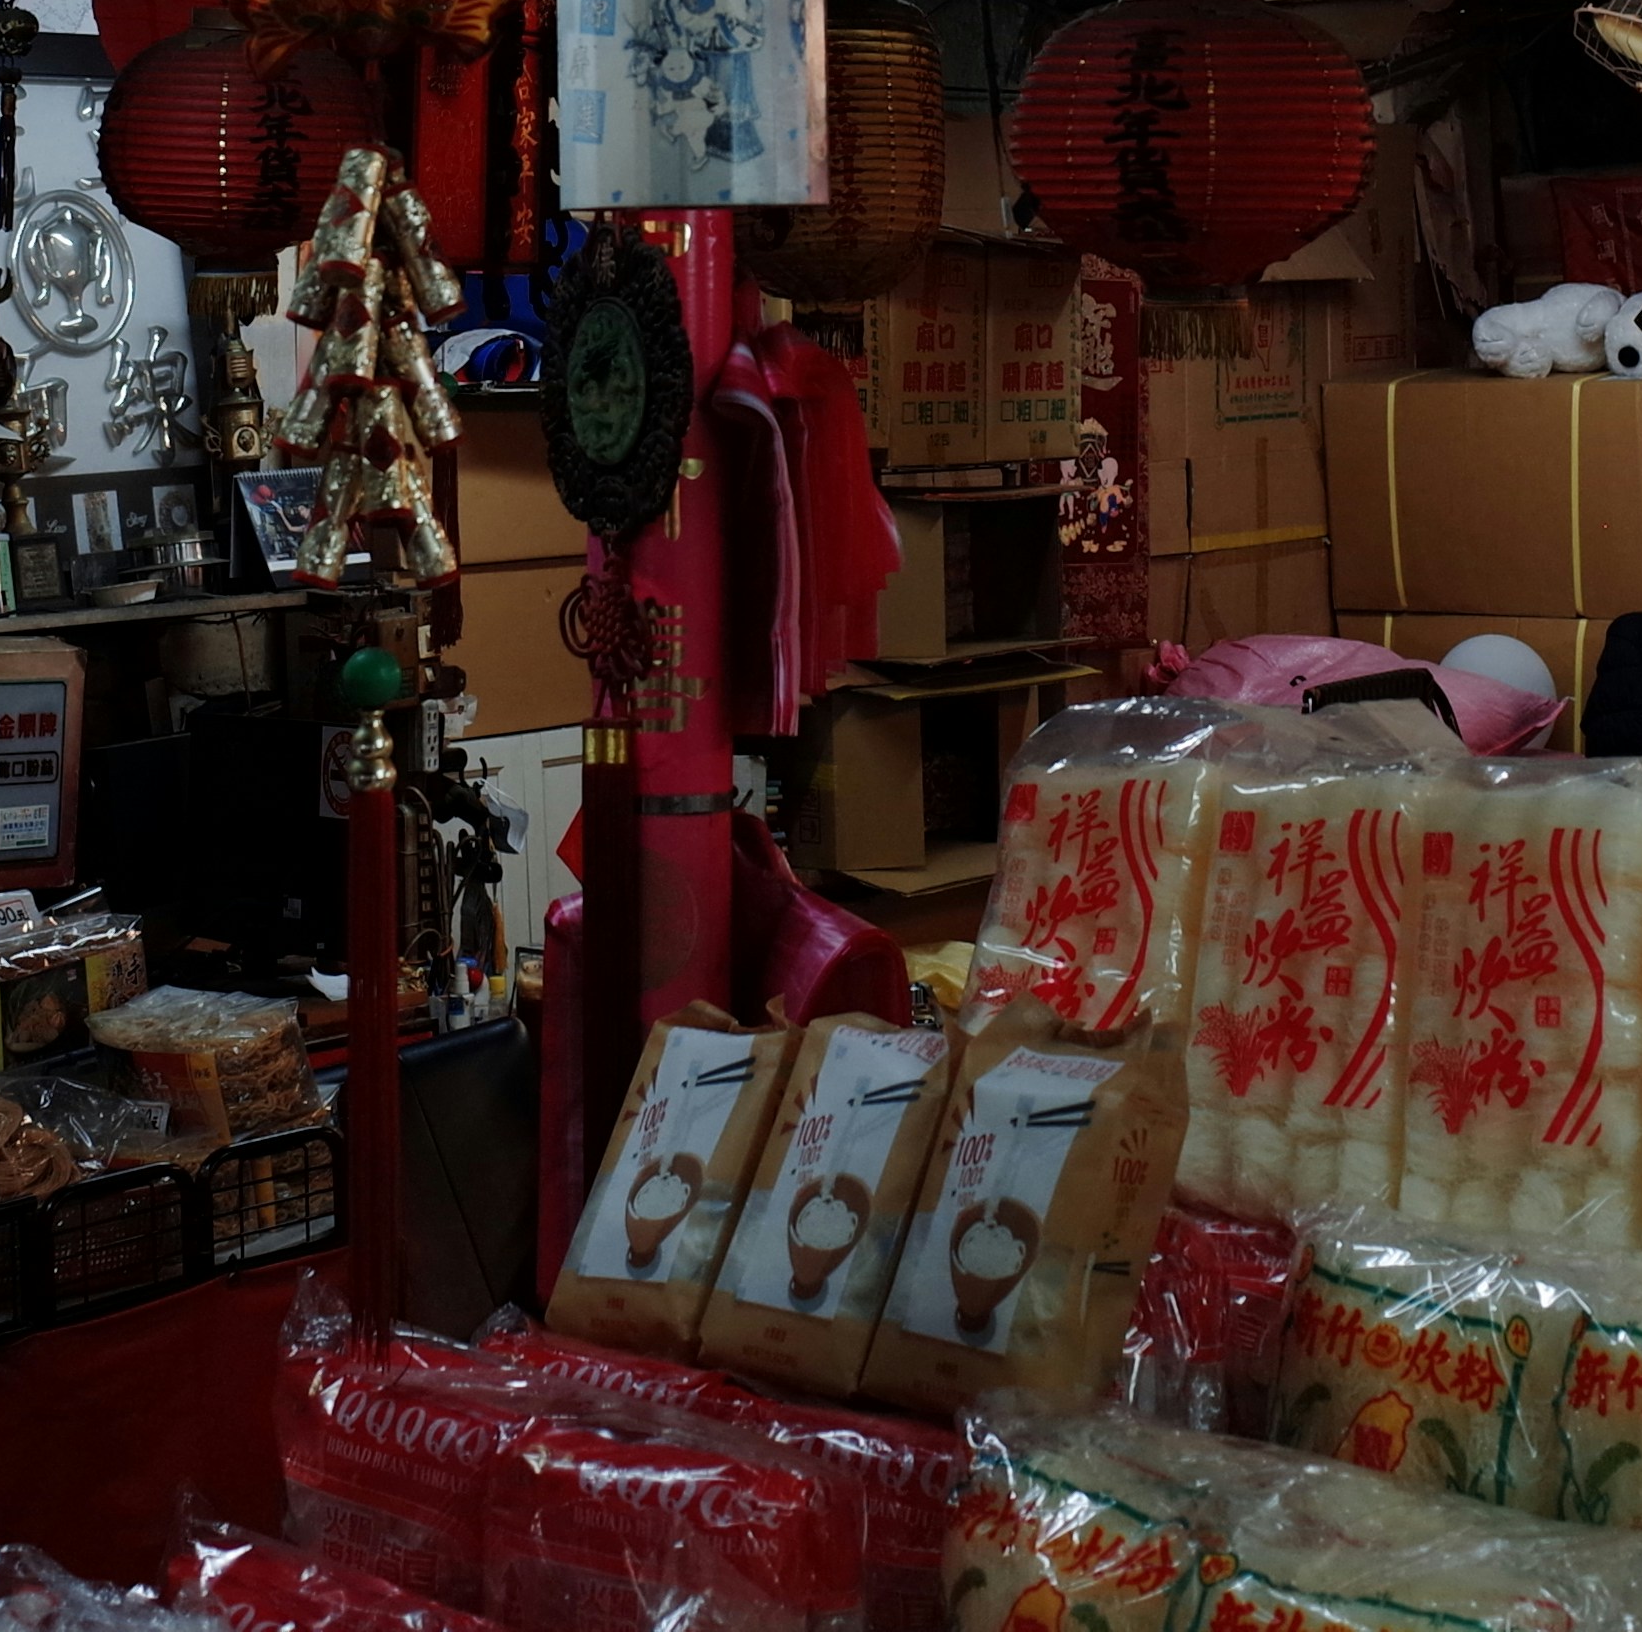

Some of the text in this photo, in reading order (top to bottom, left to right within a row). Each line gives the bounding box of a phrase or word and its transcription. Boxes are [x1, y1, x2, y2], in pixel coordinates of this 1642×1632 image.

[796, 1111, 836, 1148] 100%
[957, 1132, 998, 1168] 100%
[1402, 1329, 1506, 1412] 炊粉
